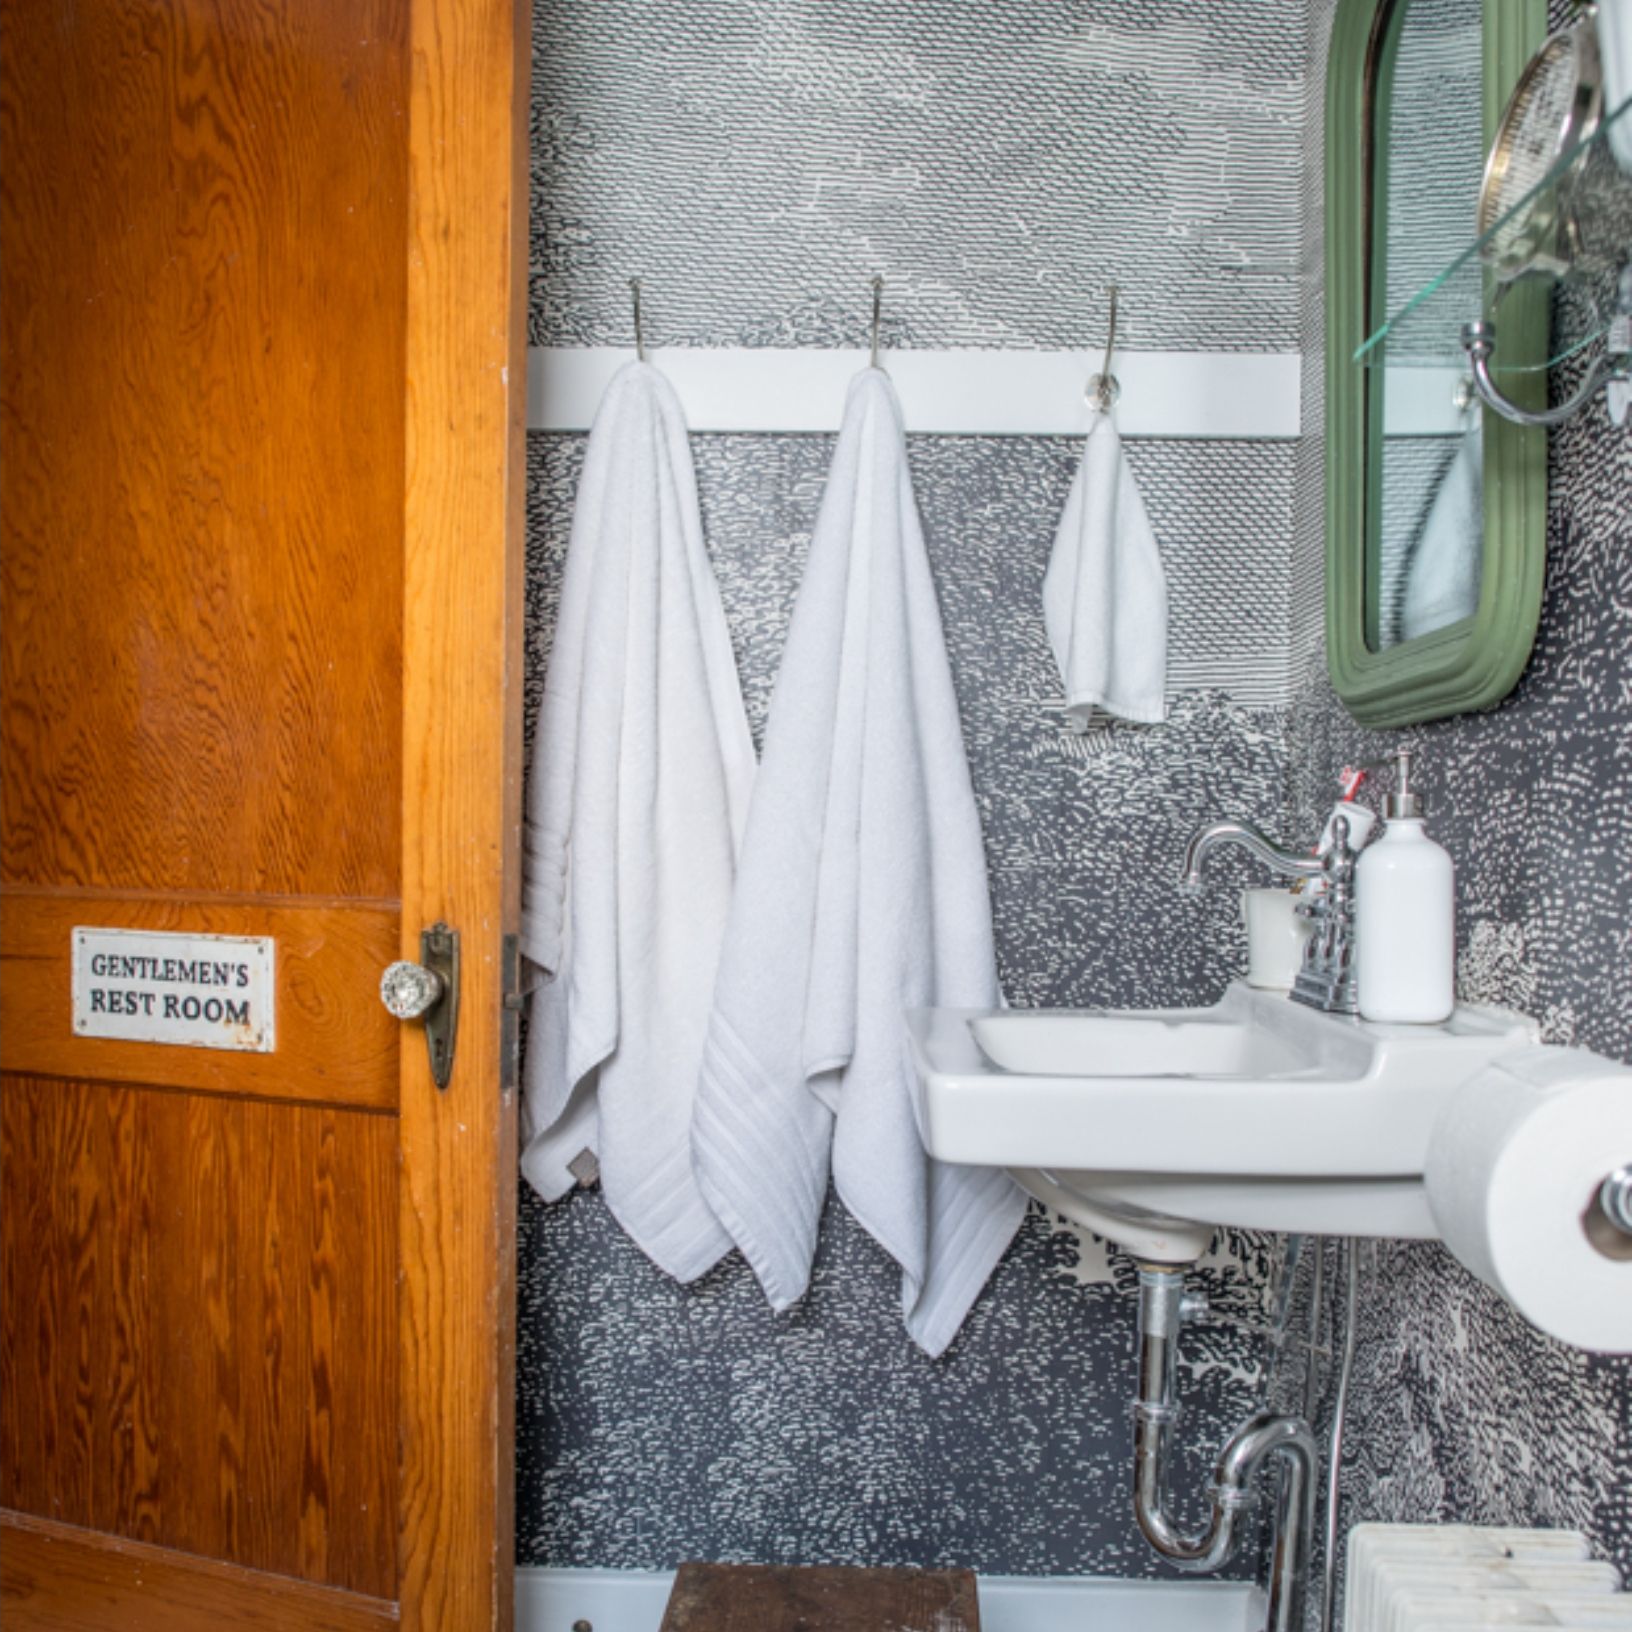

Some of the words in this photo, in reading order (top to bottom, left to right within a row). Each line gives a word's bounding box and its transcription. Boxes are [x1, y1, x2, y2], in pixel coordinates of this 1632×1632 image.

[91, 953, 249, 988] GENTLEMEN'S
[90, 988, 156, 1016] REST
[163, 993, 251, 1026] ROOM
